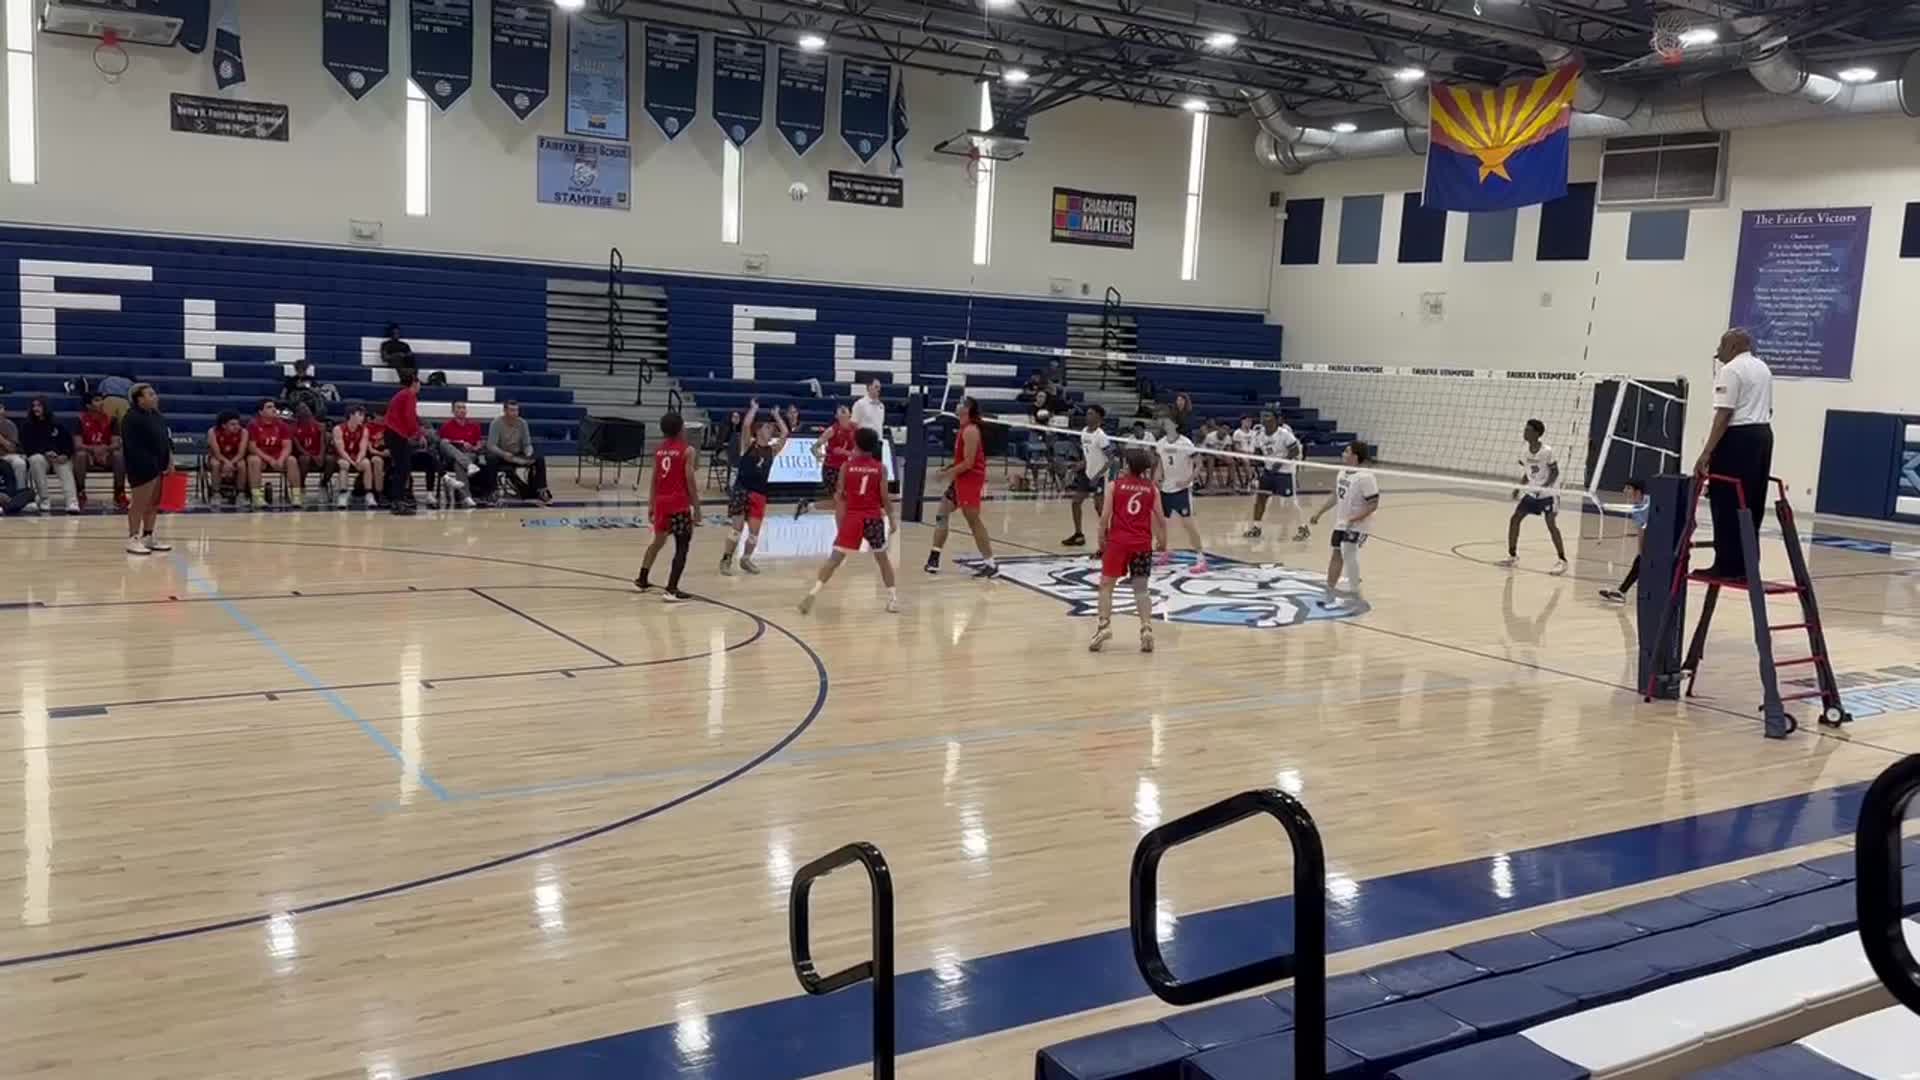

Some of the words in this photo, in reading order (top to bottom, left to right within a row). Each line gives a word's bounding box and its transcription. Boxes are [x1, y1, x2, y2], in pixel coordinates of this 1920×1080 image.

[540, 138, 576, 152] FAIRFAX
[553, 191, 613, 207] STAMPEDE
[1082, 197, 1134, 217] CHARACTER
[1082, 214, 1133, 235] MATTERS
[1754, 214, 1774, 225] The
[1777, 213, 1814, 224] Fairfax
[1818, 212, 1857, 223] Victors
[1412, 367, 1438, 376] FAIRFAX
[1440, 368, 1475, 378] STAMPEDE
[1506, 370, 1537, 380] FAIRFAX
[1538, 372, 1577, 382] STAMPEDE
[661, 456, 671, 478] 9
[859, 475, 869, 495] 1
[1127, 491, 1143, 515] 6
